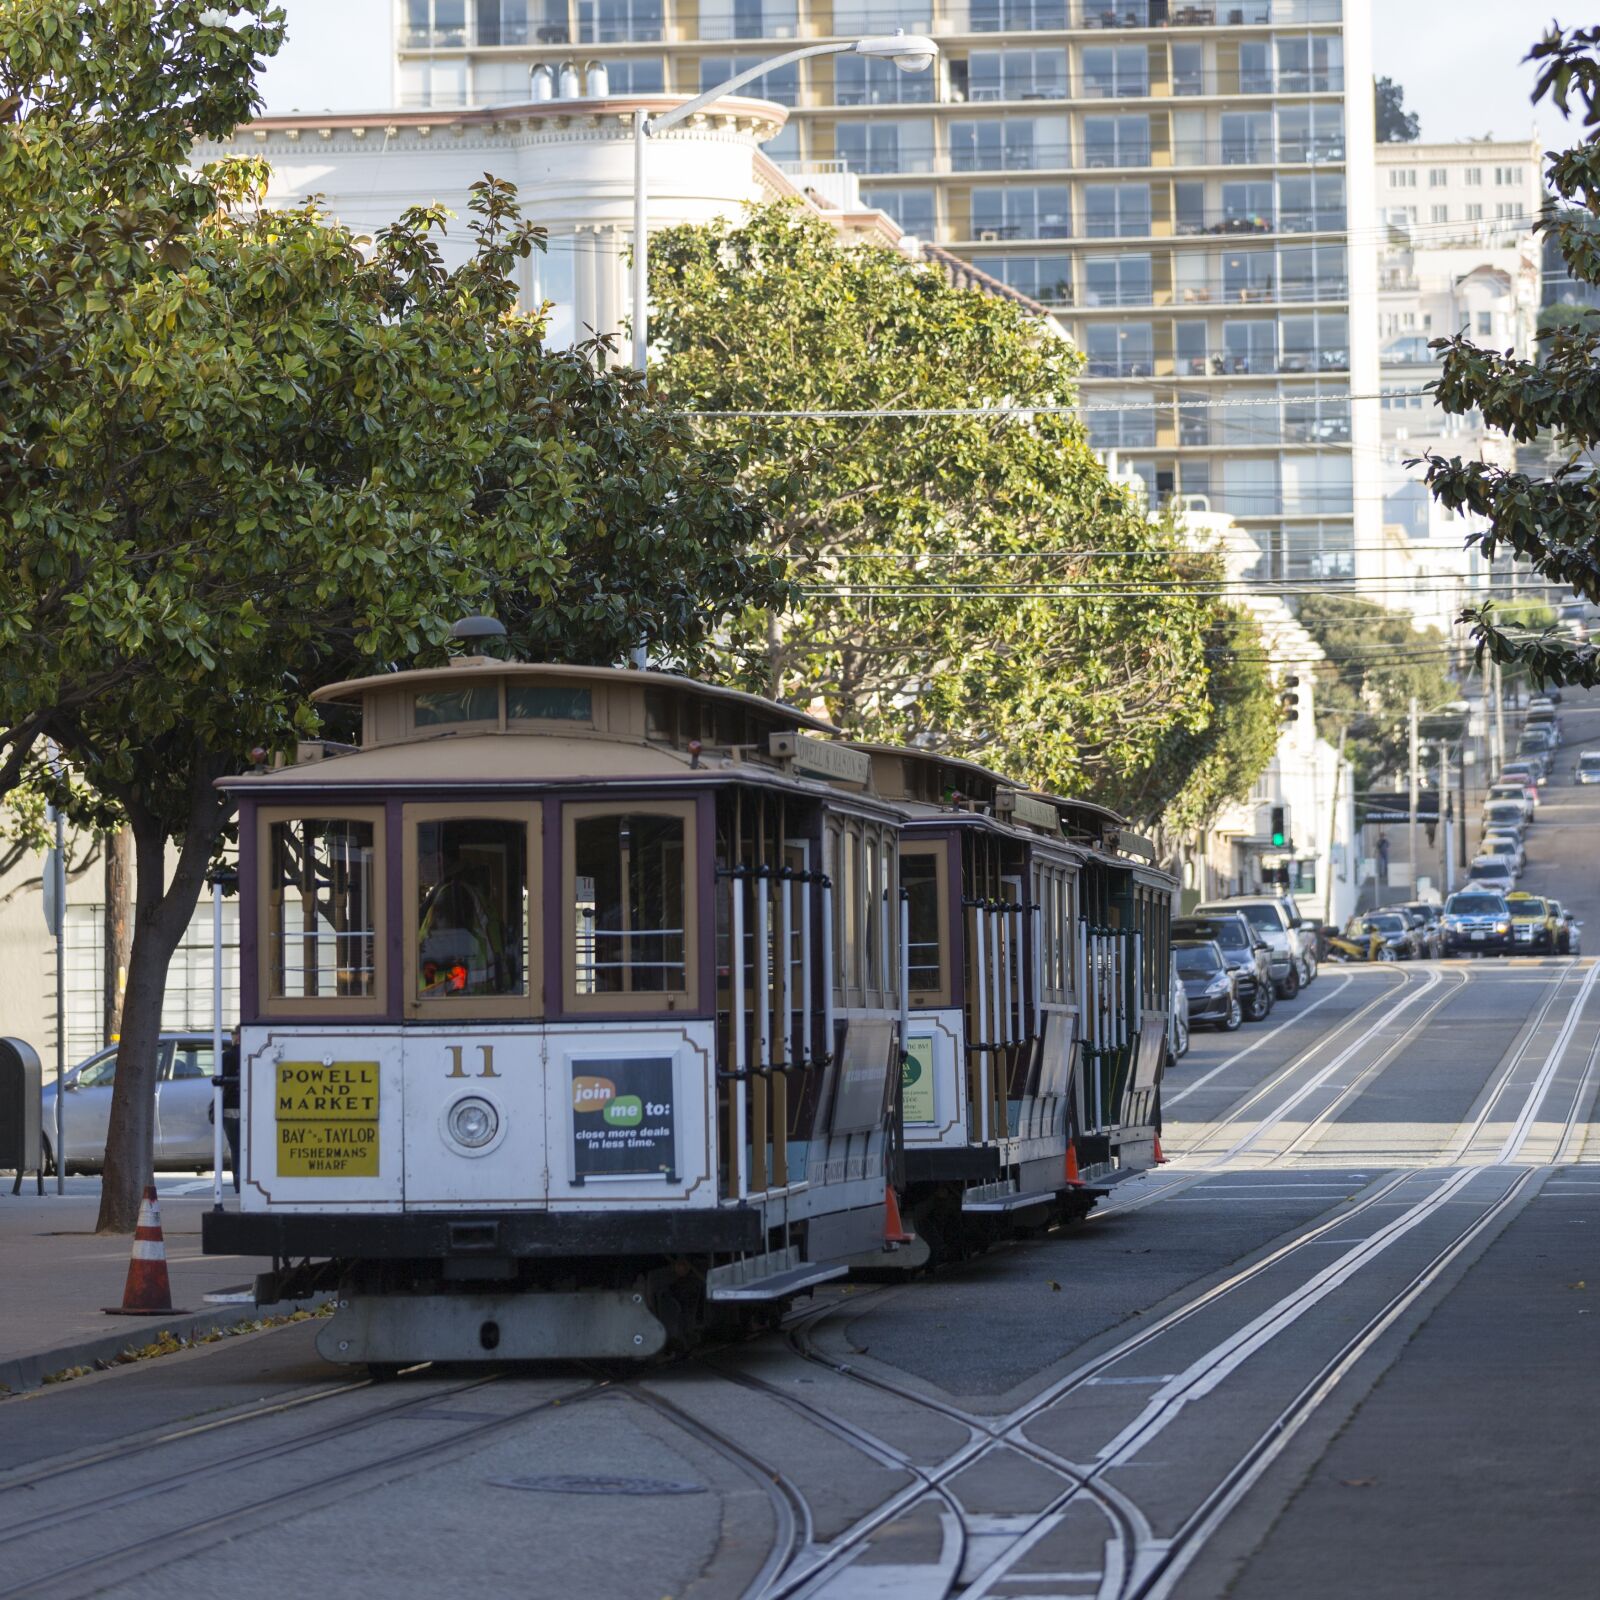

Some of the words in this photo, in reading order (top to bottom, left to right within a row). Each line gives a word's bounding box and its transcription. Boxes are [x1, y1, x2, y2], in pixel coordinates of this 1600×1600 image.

[444, 1045, 502, 1078] 11
[282, 1069, 373, 1083] POWELL
[306, 1085, 350, 1095] AND
[575, 1082, 611, 1103] join
[280, 1097, 374, 1110] MARKET
[610, 1104, 638, 1117] me
[645, 1102, 670, 1116] to:
[282, 1128, 305, 1144] BAY
[325, 1128, 375, 1144] TAYLOR
[576, 1130, 605, 1140] close
[608, 1129, 637, 1138] more
[640, 1126, 670, 1137] deals
[588, 1139, 599, 1149] in
[602, 1138, 624, 1148] less
[627, 1137, 656, 1148] time.
[290, 1147, 367, 1159] FISHERMANS
[308, 1159, 347, 1170] WHARF
